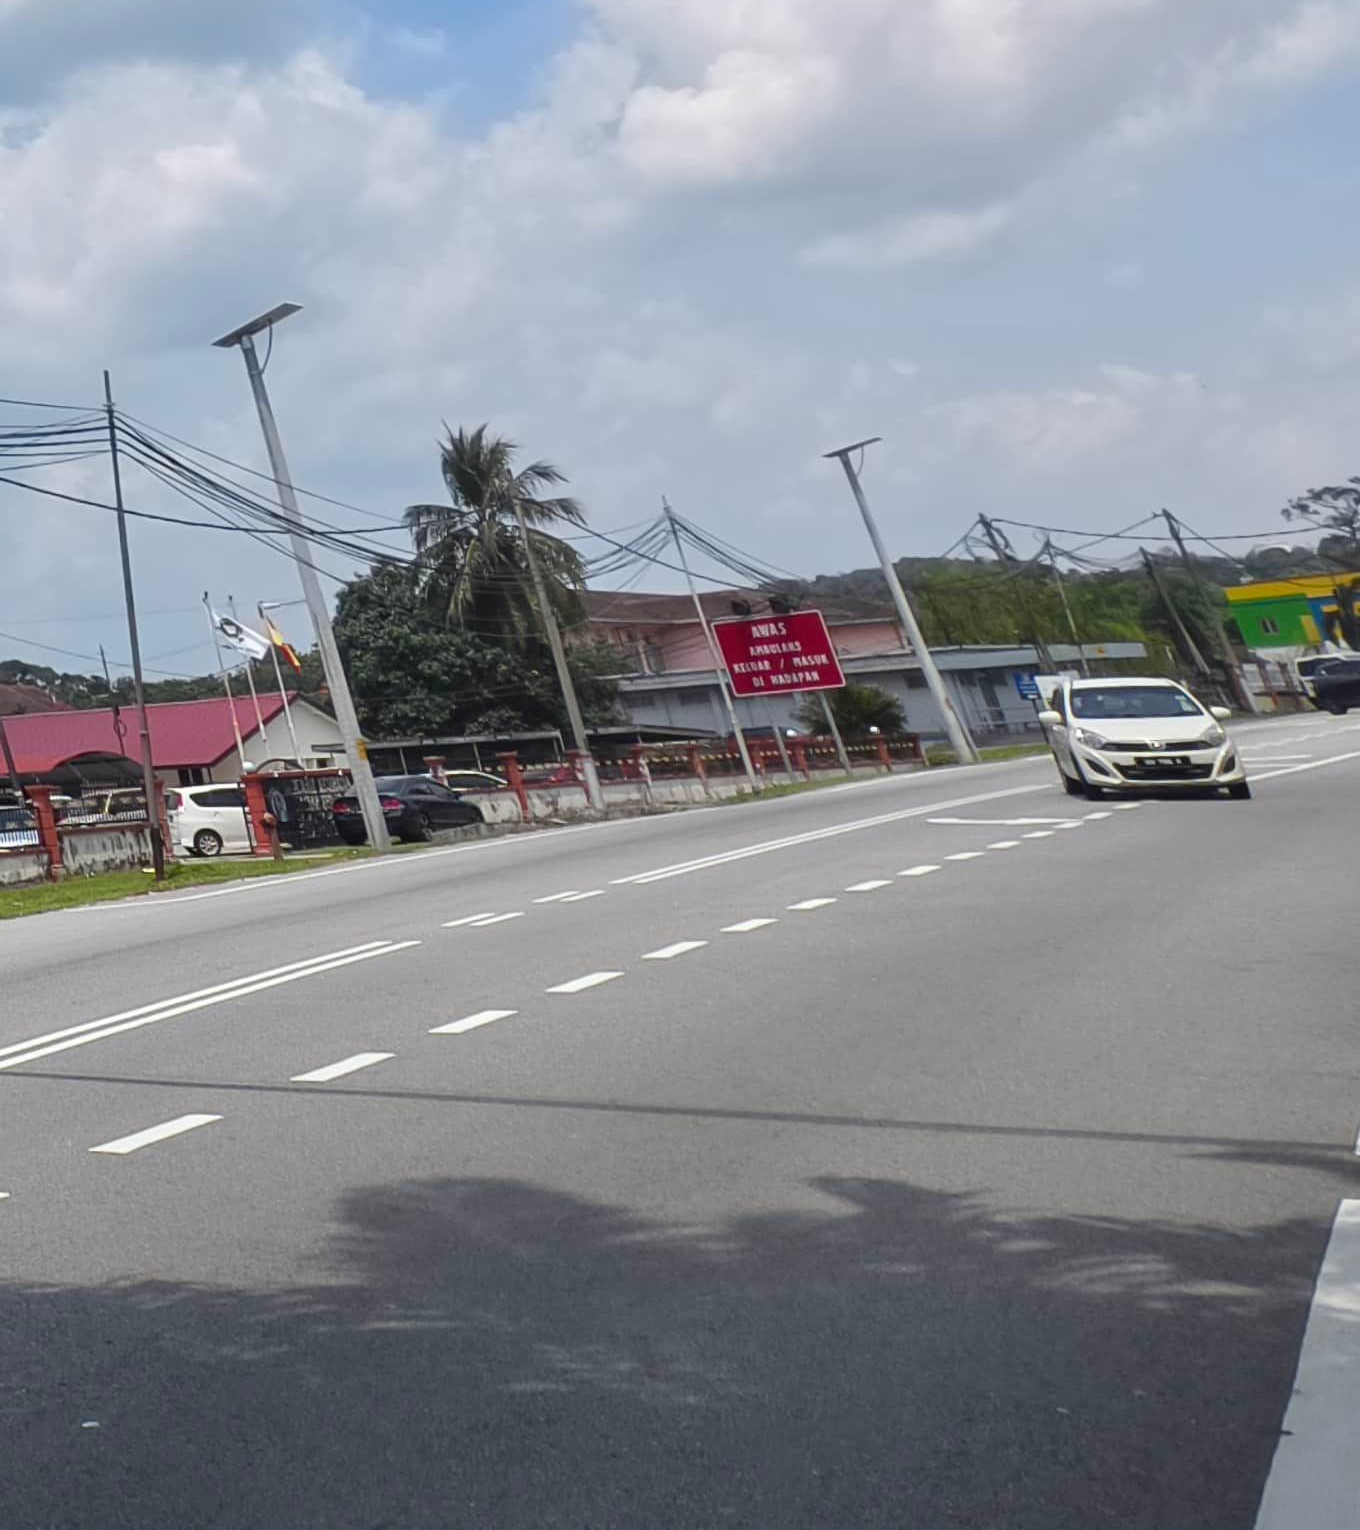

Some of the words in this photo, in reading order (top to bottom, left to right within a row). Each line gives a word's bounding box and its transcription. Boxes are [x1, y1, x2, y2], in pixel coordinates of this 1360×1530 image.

[751, 622, 787, 638] AWAS
[749, 641, 802, 656] AMBULANS
[733, 661, 771, 673] KELUAR
[792, 654, 829, 667] MASUK
[770, 671, 820, 685] HADAPAN
